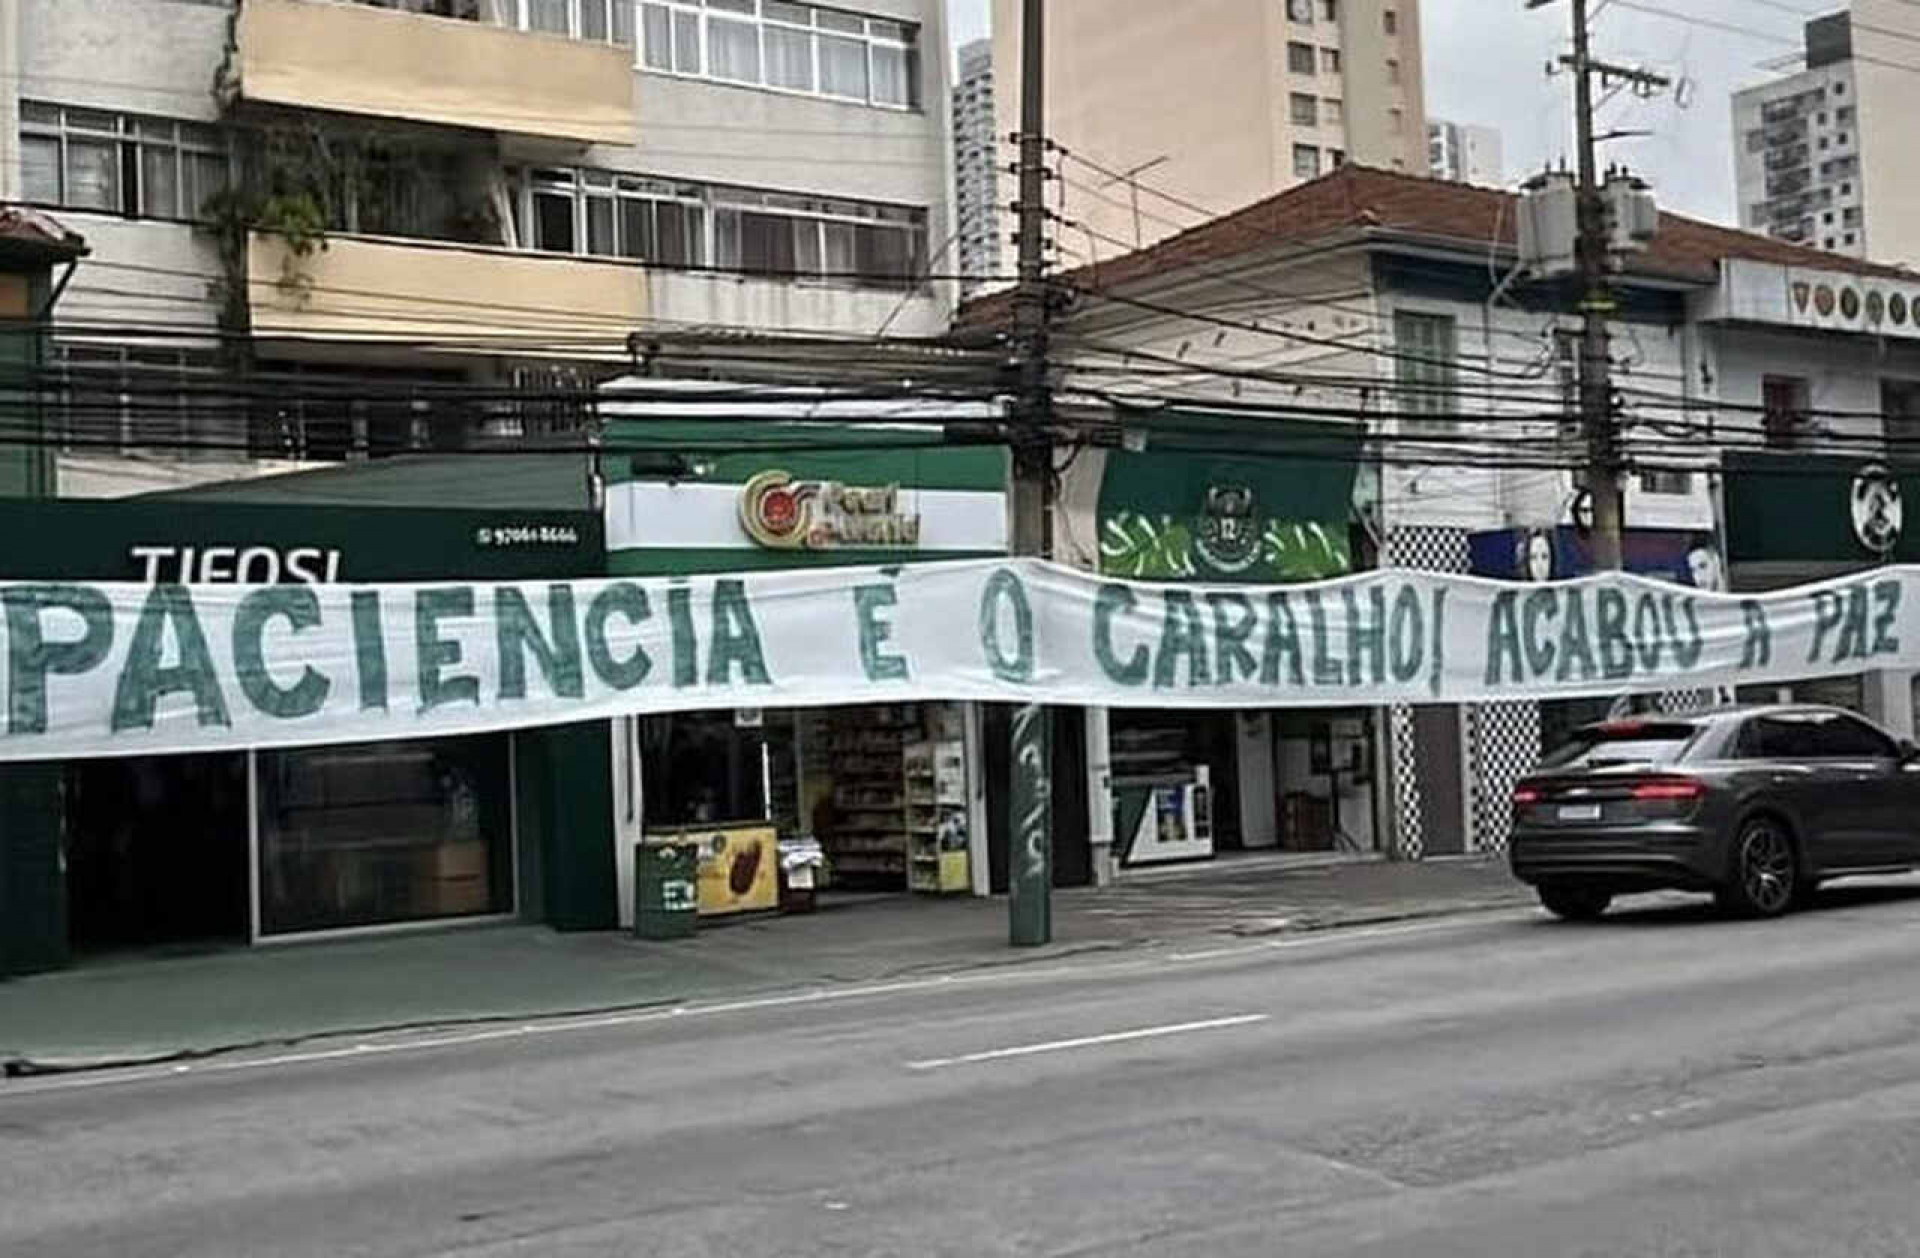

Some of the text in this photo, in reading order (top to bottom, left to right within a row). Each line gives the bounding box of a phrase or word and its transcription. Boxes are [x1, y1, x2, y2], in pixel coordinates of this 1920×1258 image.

[2, 577, 772, 735] PACIENCIA
[979, 567, 1033, 684] O
[1093, 584, 1448, 697] CARALHO!
[1485, 587, 1703, 685] ACABOU
[1741, 600, 1771, 668] A
[1807, 580, 1901, 664] PAZ
